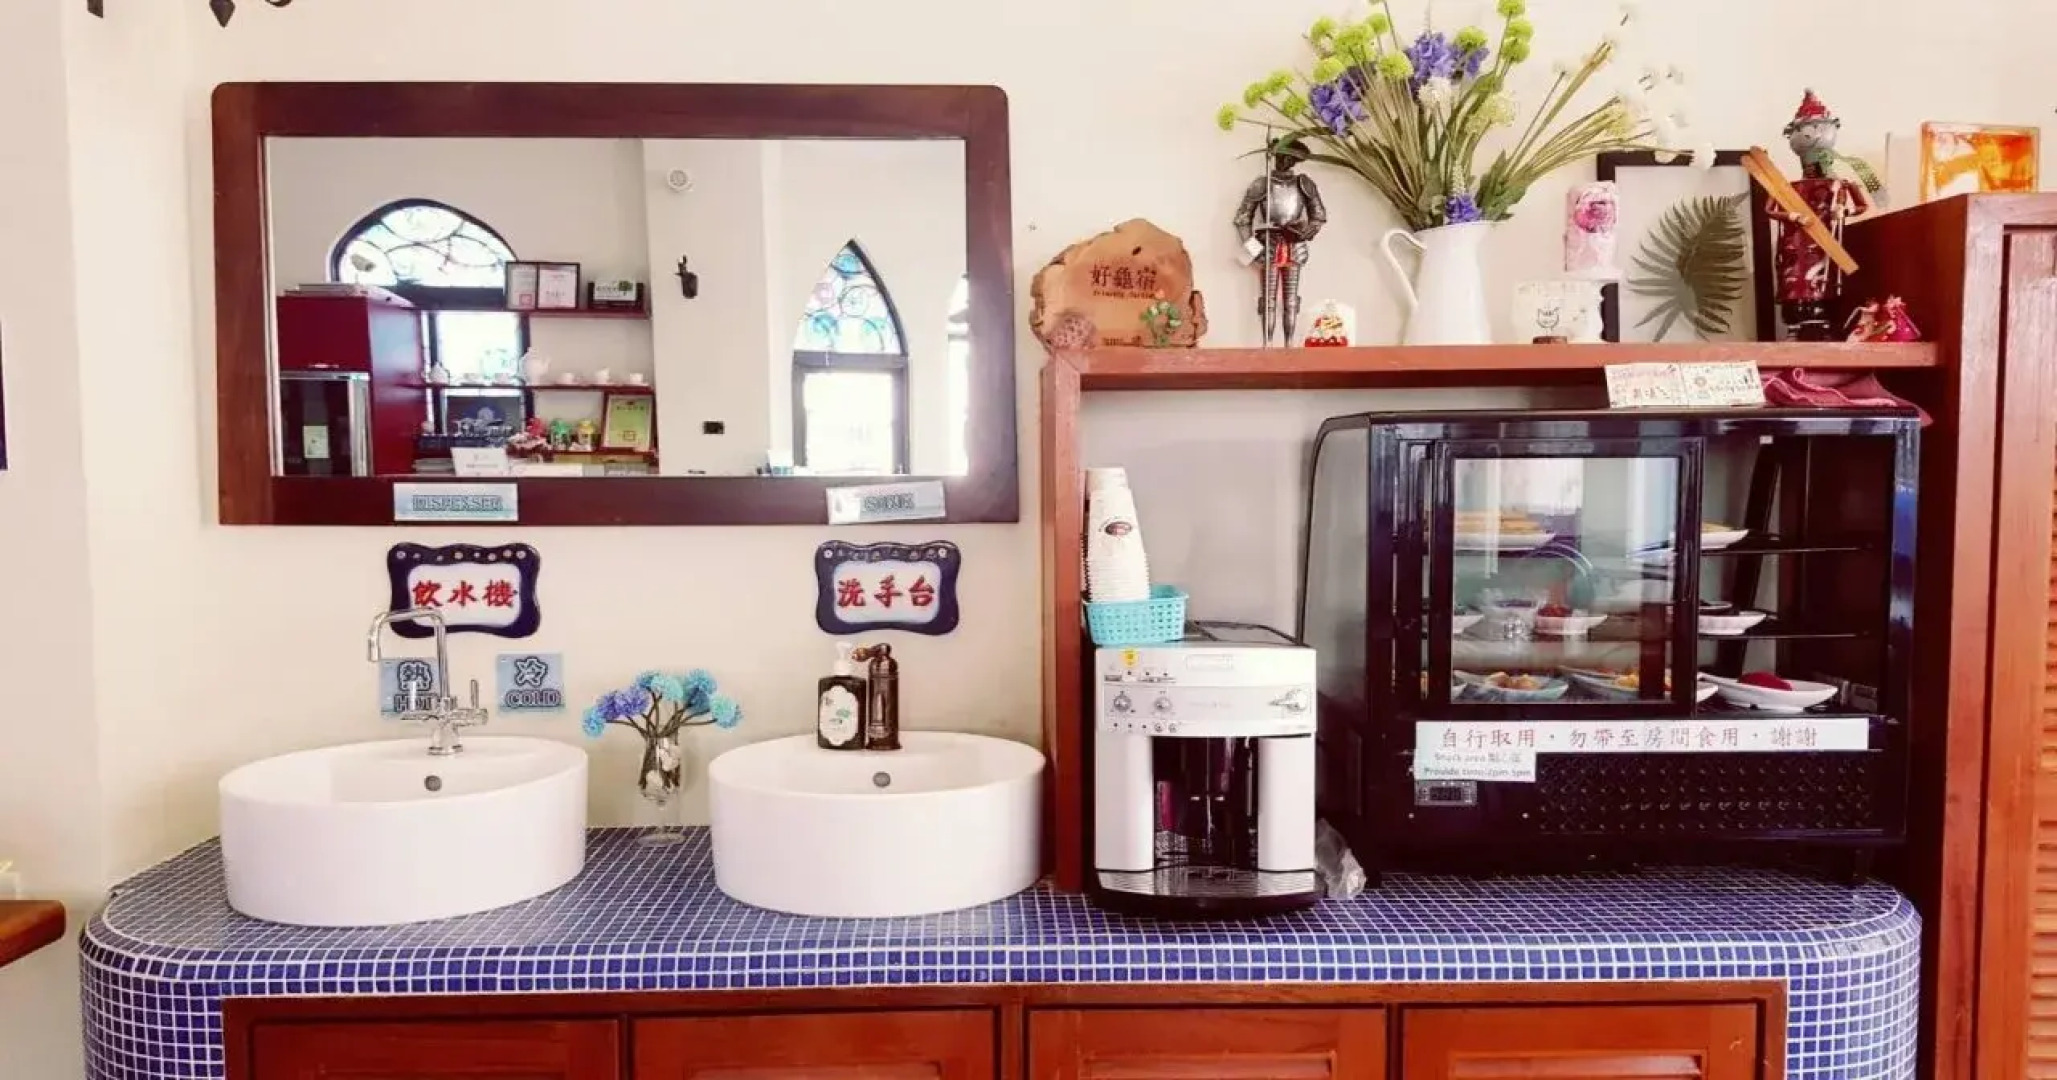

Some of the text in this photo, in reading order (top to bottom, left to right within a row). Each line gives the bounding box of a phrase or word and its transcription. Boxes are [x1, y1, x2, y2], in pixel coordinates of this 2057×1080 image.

[412, 579, 518, 608] 飲水機
[837, 575, 935, 608] 洗手台
[397, 660, 433, 691] 熱
[513, 656, 549, 688] 冷
[505, 690, 561, 708] COLD
